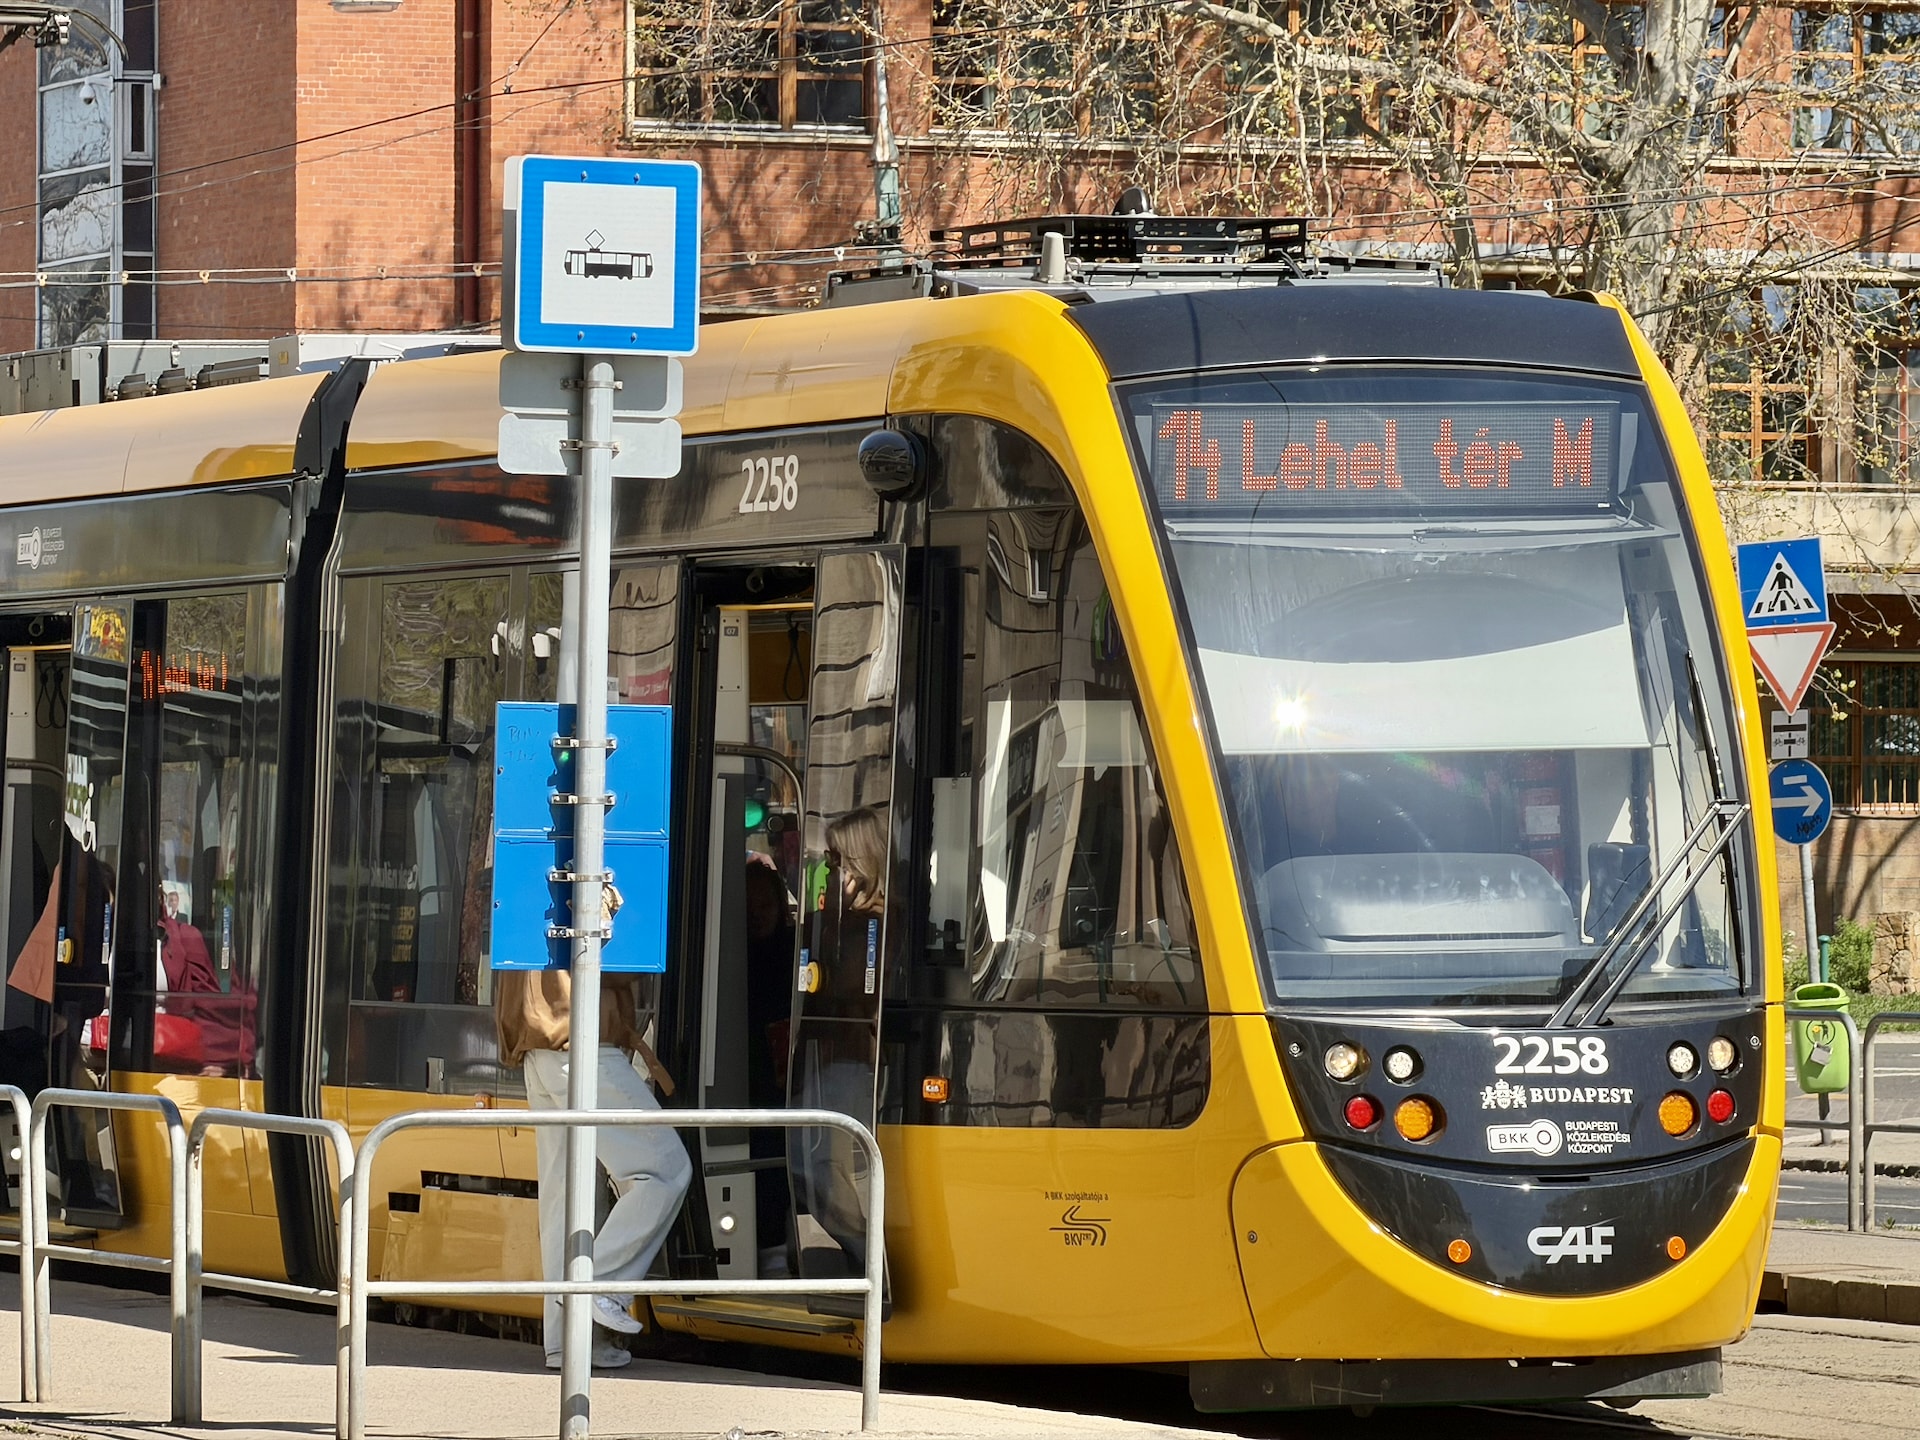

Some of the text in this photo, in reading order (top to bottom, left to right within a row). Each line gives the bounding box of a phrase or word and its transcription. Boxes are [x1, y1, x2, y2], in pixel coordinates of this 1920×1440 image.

[1158, 410, 1594, 500] 14 Lehel tér M
[739, 454, 799, 514] 2258
[157, 652, 191, 694] Lehel
[1493, 1036, 1609, 1075] 2258
[1530, 1087, 1634, 1104] BUDAPEST
[1498, 1132, 1529, 1144] BKK
[1565, 1121, 1619, 1131] BUDAPESTI
[1566, 1132, 1631, 1143] KÖZLEKEDÉSI
[1568, 1143, 1614, 1154] KÖZPONT
[1527, 1226, 1615, 1264] CAF
